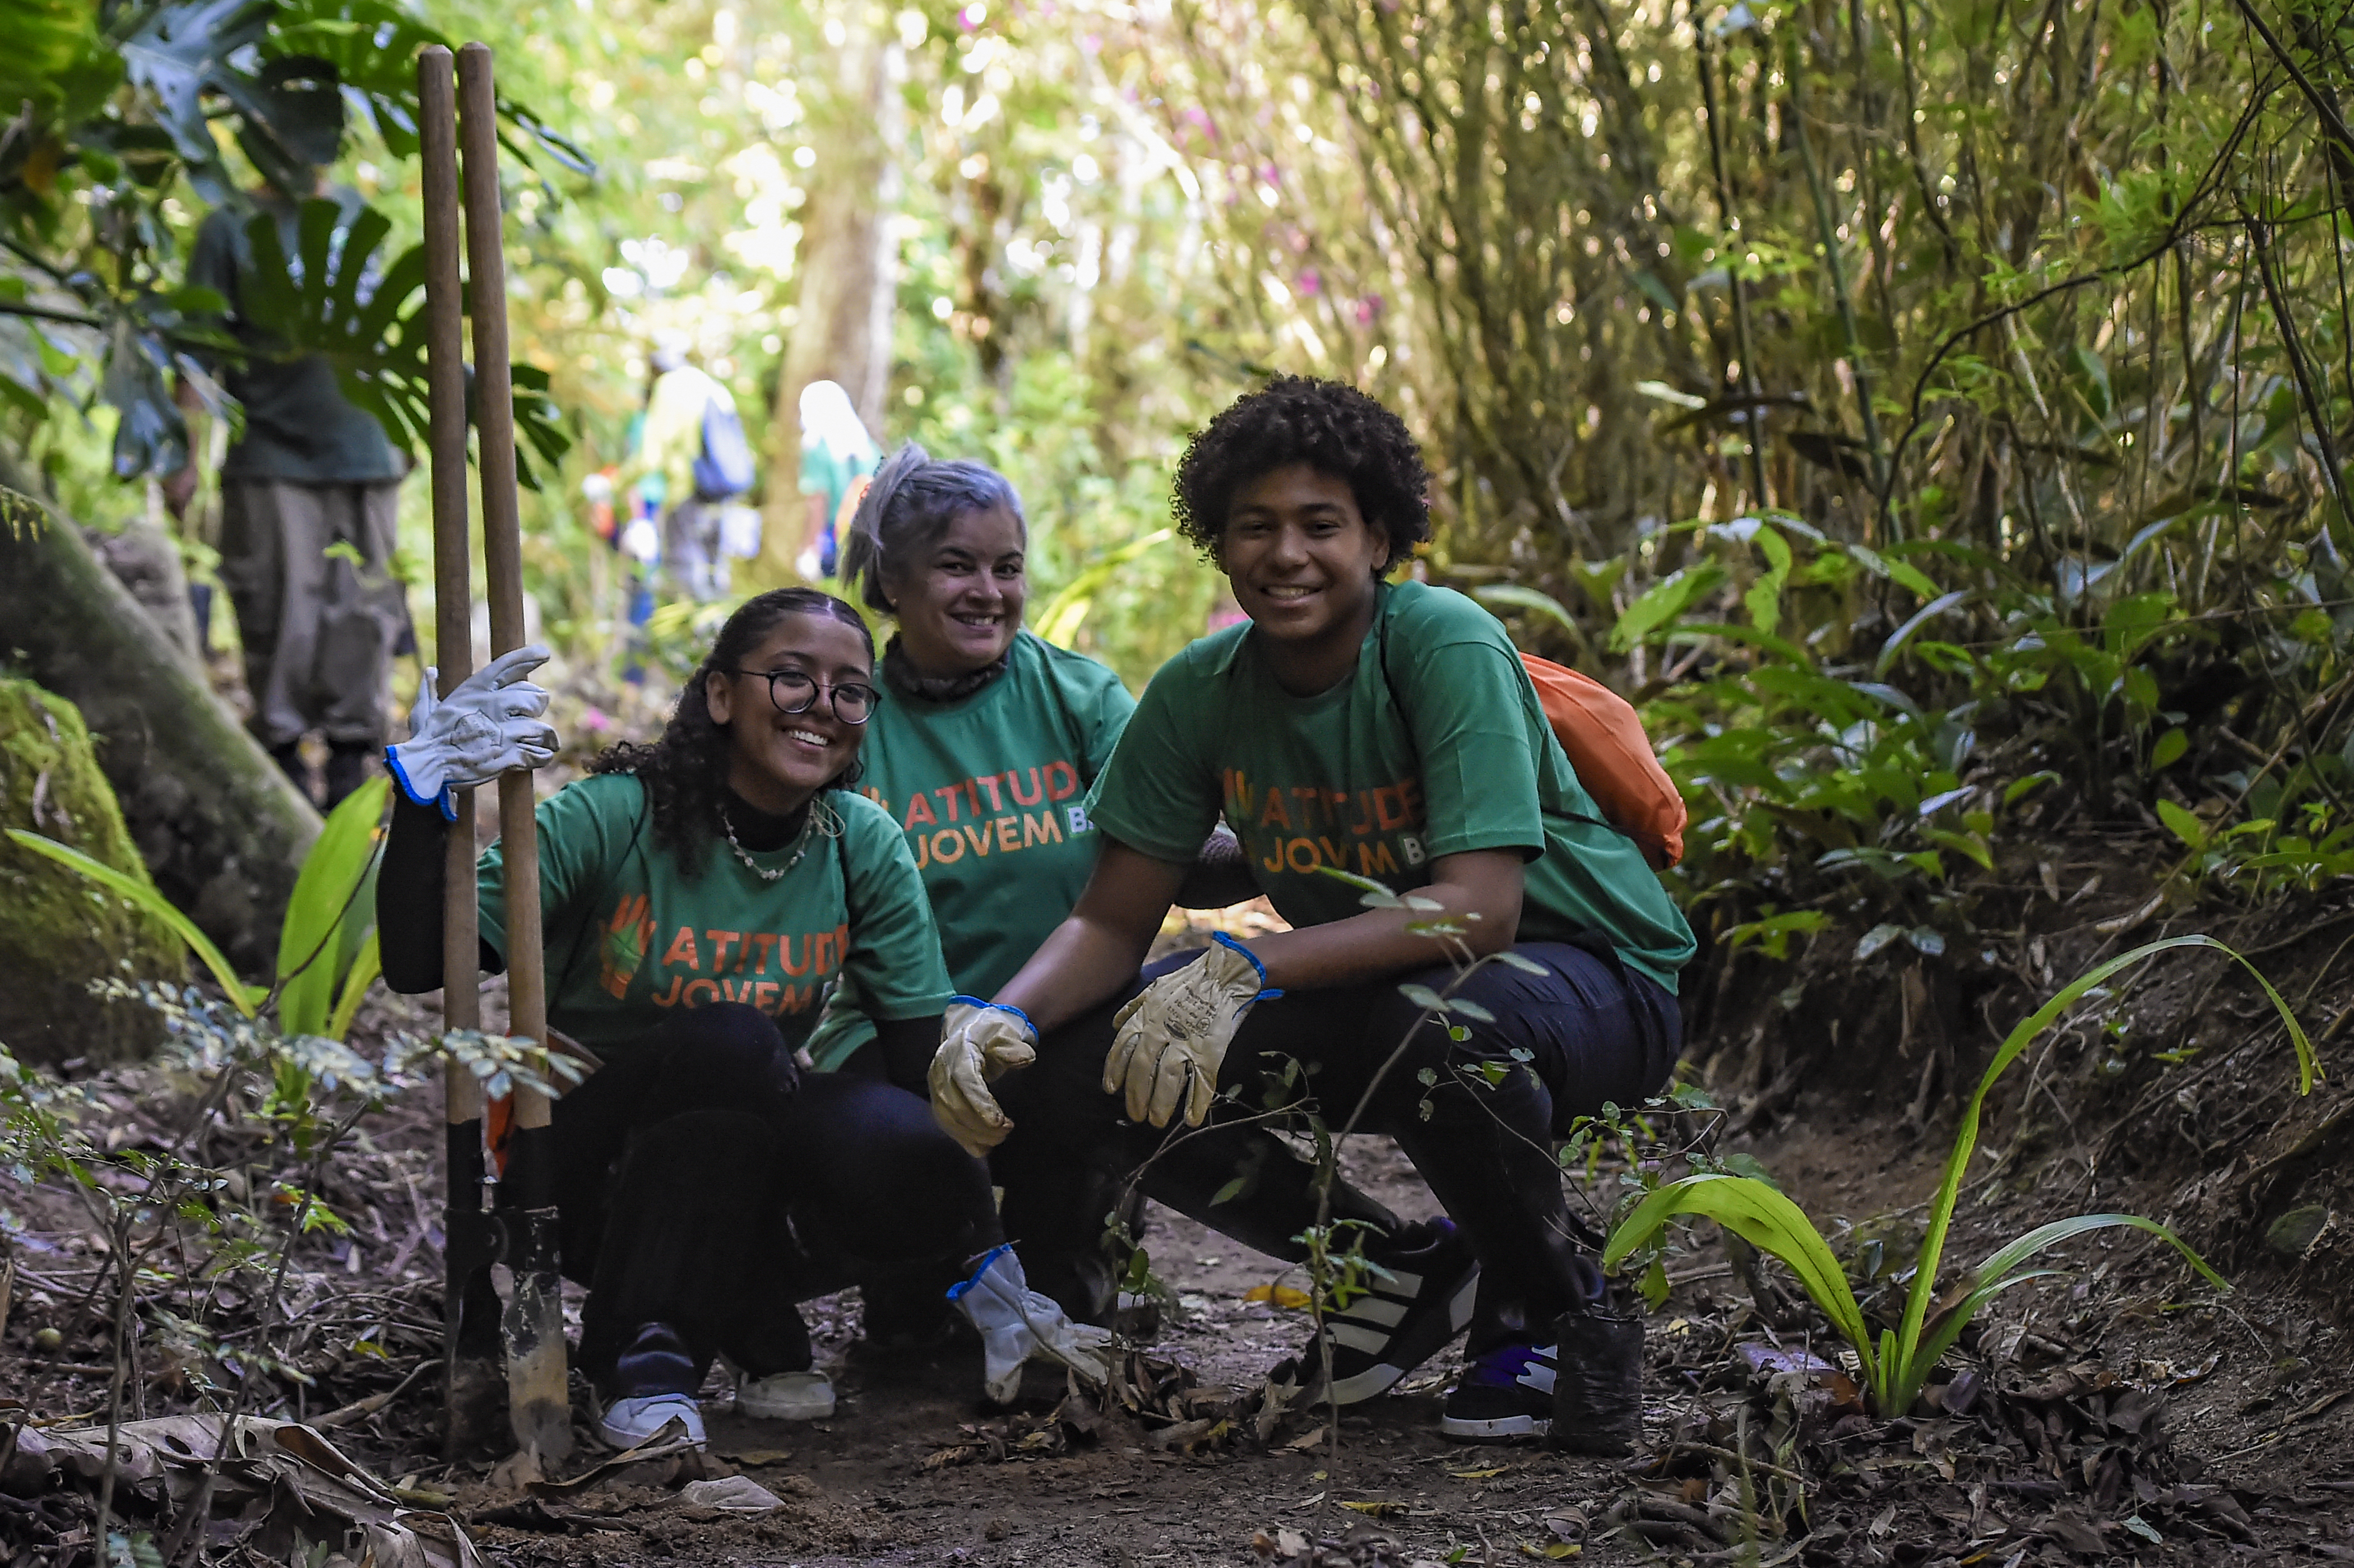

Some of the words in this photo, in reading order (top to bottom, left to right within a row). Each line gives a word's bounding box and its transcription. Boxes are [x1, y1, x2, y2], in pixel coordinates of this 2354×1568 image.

[916, 810, 1063, 870] JOVEM
[1067, 806, 1095, 834] B
[1263, 836, 1400, 876] JOVM
[651, 975, 813, 1015] JOVEM
